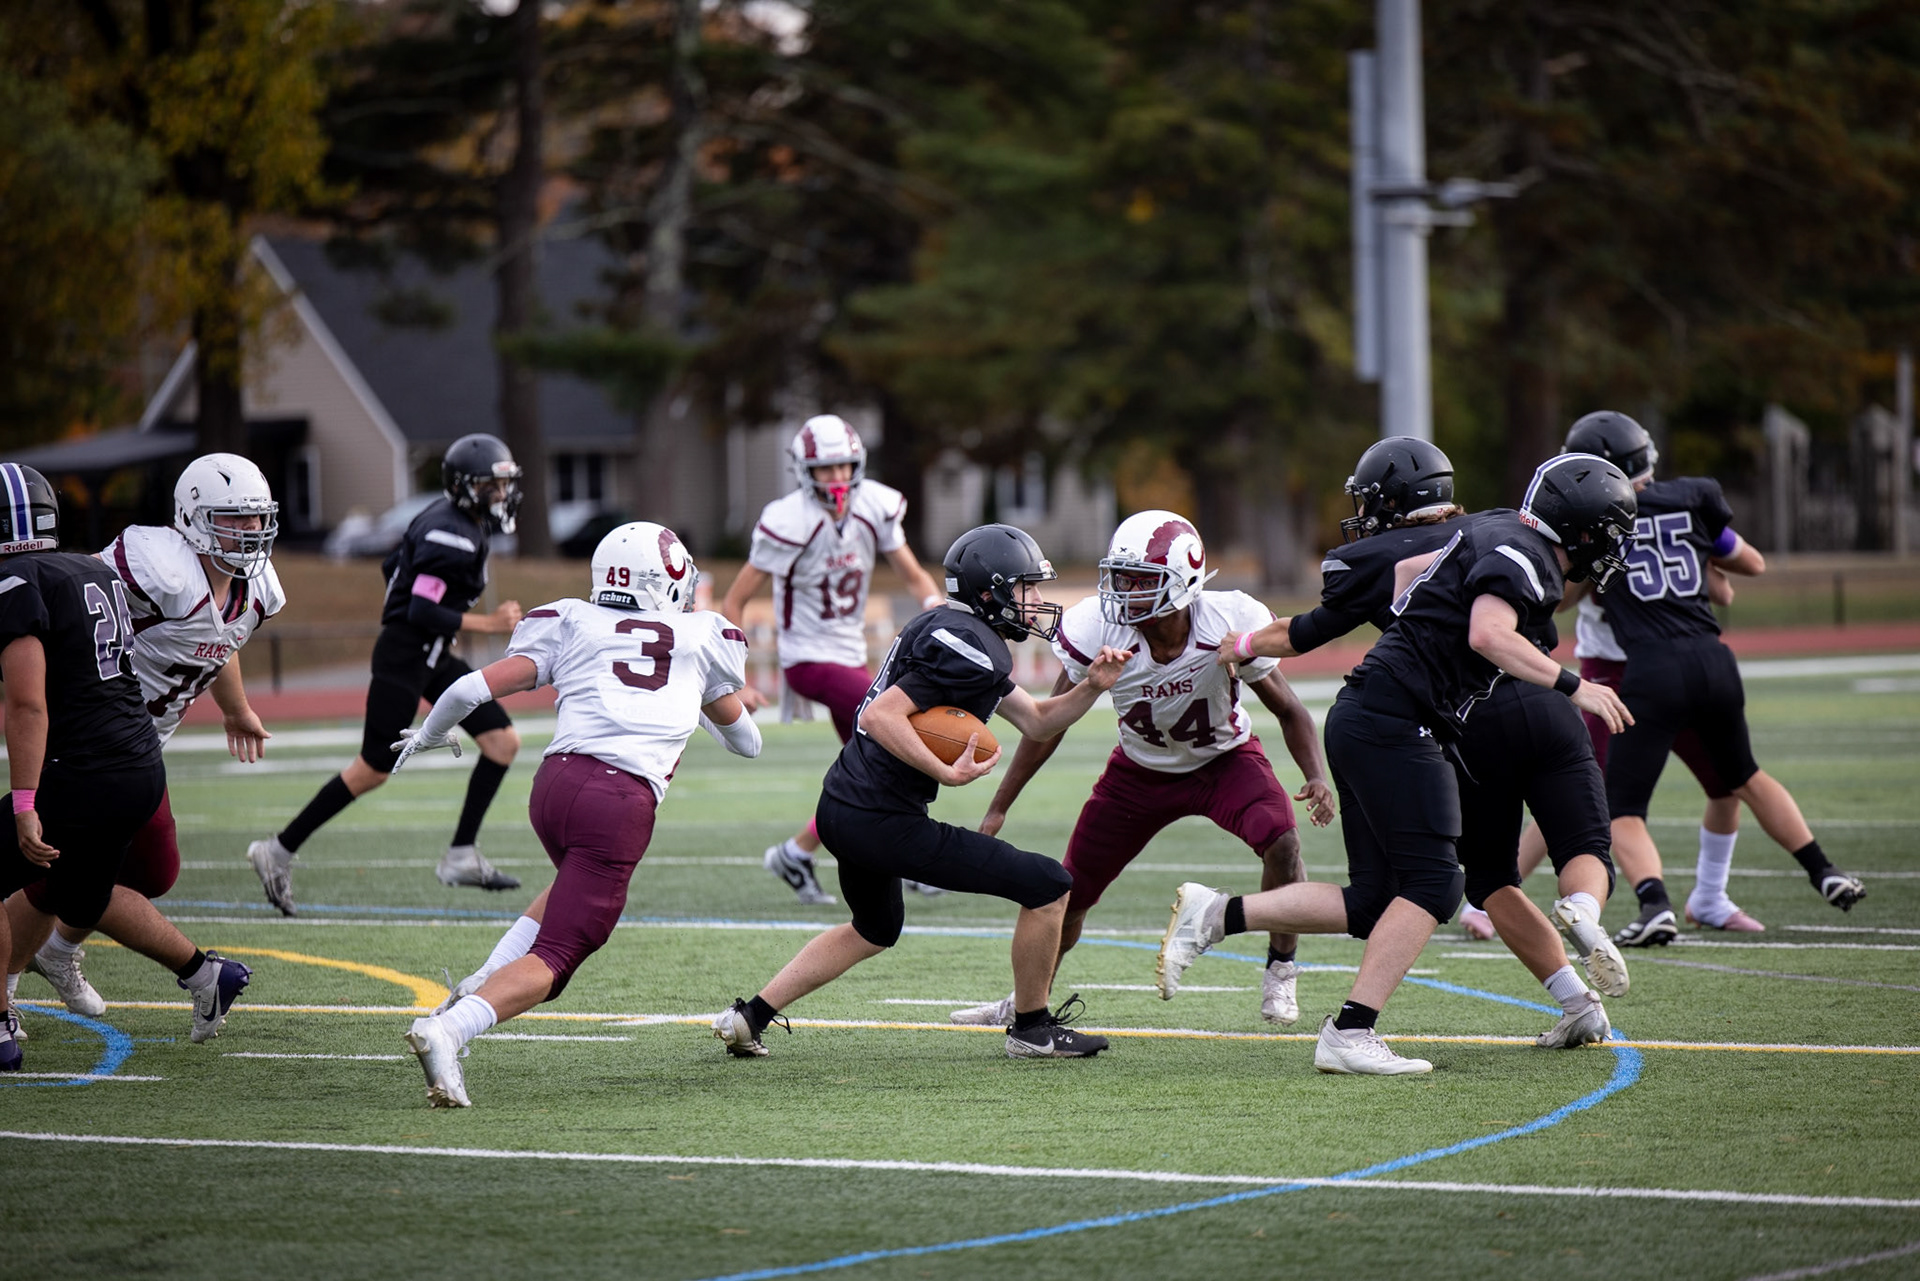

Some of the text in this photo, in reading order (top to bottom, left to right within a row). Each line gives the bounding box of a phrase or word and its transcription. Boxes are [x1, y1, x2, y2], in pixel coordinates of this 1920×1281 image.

[3, 540, 43, 553] Riddell
[1617, 511, 1702, 602] 55
[605, 566, 631, 588] 49
[818, 569, 864, 620] 19
[194, 642, 231, 659] RAMS
[612, 618, 676, 692] 3
[1142, 679, 1194, 699] RAMS
[1120, 698, 1217, 749] 44
